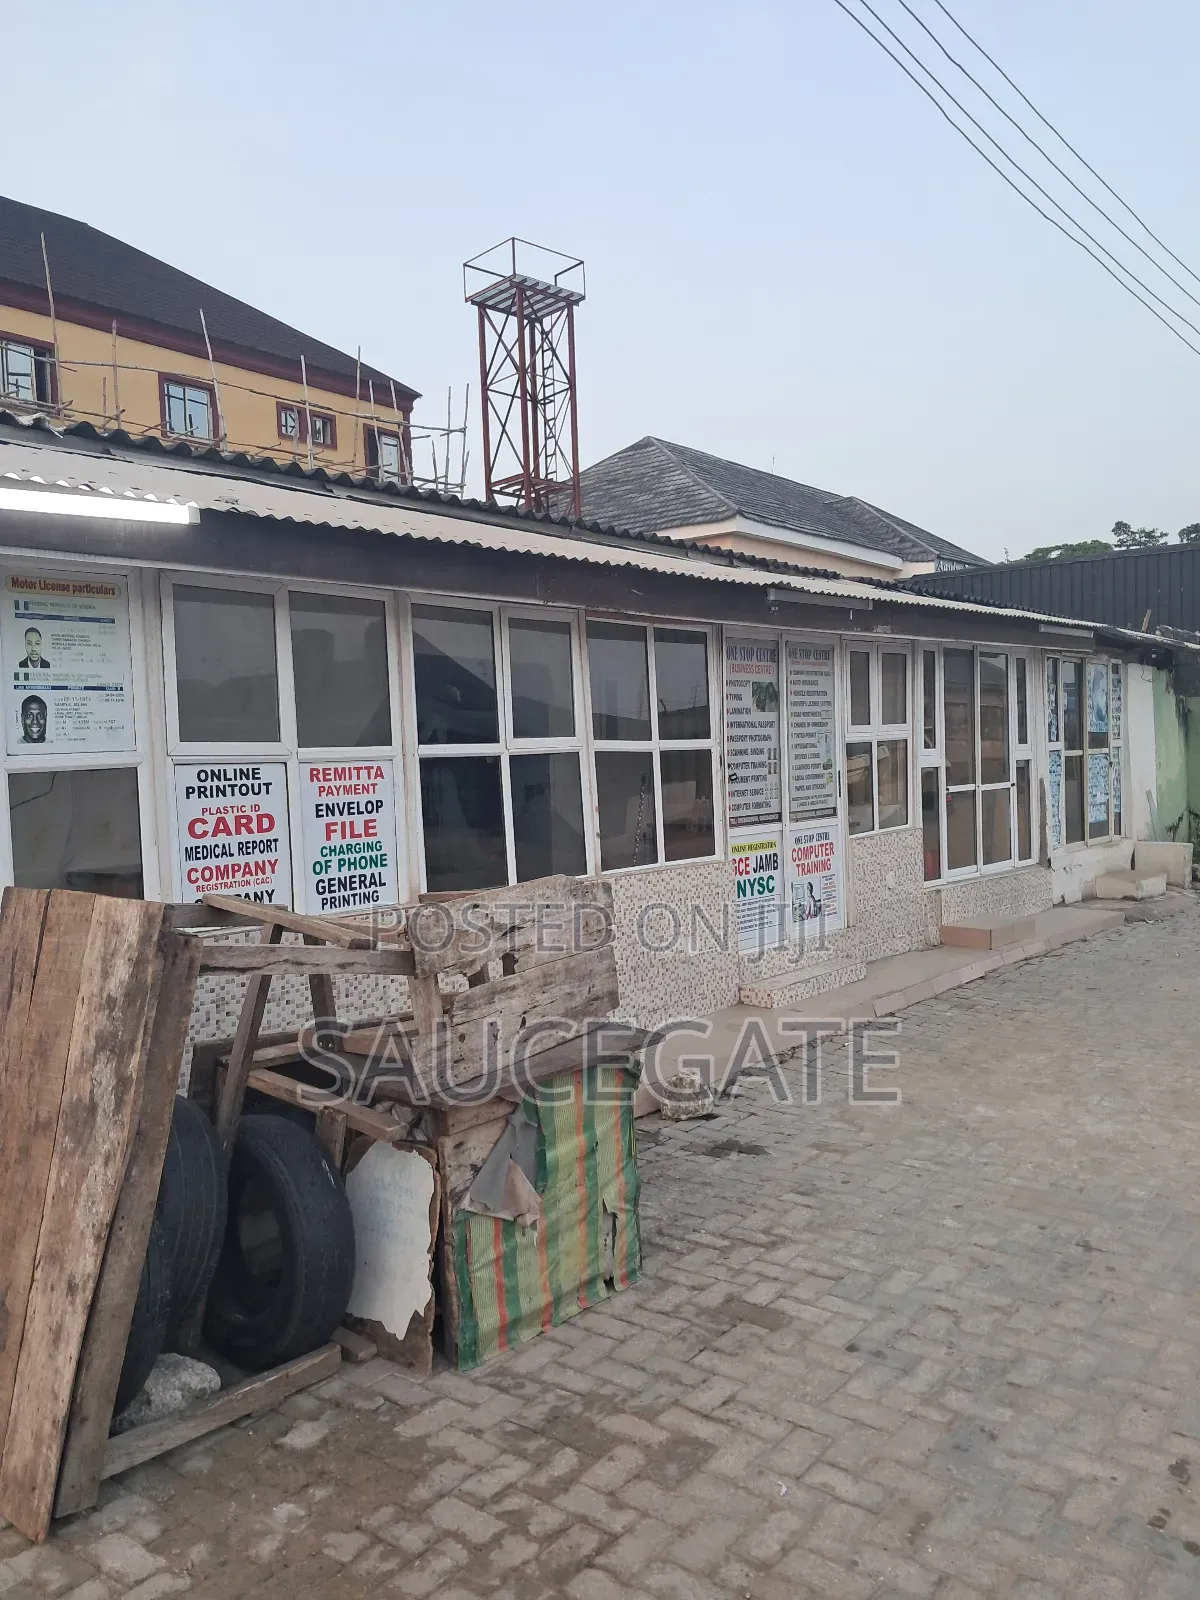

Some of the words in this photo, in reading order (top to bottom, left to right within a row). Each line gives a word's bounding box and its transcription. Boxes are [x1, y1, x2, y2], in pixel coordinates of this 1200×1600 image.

[12, 577, 37, 590] Motor
[39, 580, 70, 592] License
[72, 583, 116, 596] particulars
[726, 646, 737, 660] ONE
[740, 647, 754, 661] STOP
[756, 648, 776, 662] CENTRE
[788, 648, 798, 659] ONE
[799, 648, 811, 660] STOP
[813, 650, 830, 660] CENTRE
[751, 761, 767, 769] TRAINING
[196, 768, 261, 782] ONLINE
[309, 766, 384, 782] REMITTA
[751, 775, 767, 783] PRINTING
[186, 782, 272, 799] PRINTOUT
[318, 783, 378, 797] PAYMENT
[749, 788, 764, 796] SERVICE
[202, 805, 246, 816] PLASTIC
[250, 804, 260, 813] ID
[315, 800, 383, 818] ENVELOP
[731, 803, 751, 811] COMPUTER
[188, 813, 275, 839] CARD
[325, 819, 377, 841] FILE
[803, 834, 814, 844] STOP
[816, 832, 829, 841] CENTRE
[185, 842, 234, 862] MEDICAL
[238, 838, 279, 856] REPORT
[320, 841, 382, 858] CHARGING
[732, 845, 747, 853] ONLINE
[792, 842, 835, 862] COMPUTER
[187, 858, 279, 884] COMPANY
[312, 859, 335, 876] OF
[338, 853, 388, 873] PHONE
[753, 853, 778, 873] JAMB
[796, 858, 831, 877] TRAINING
[196, 879, 251, 893] REGISTRATION
[253, 876, 272, 887] (CAC)
[316, 872, 386, 896] GENERAL
[737, 875, 775, 898] NYSC
[321, 890, 379, 911] PRINTING
